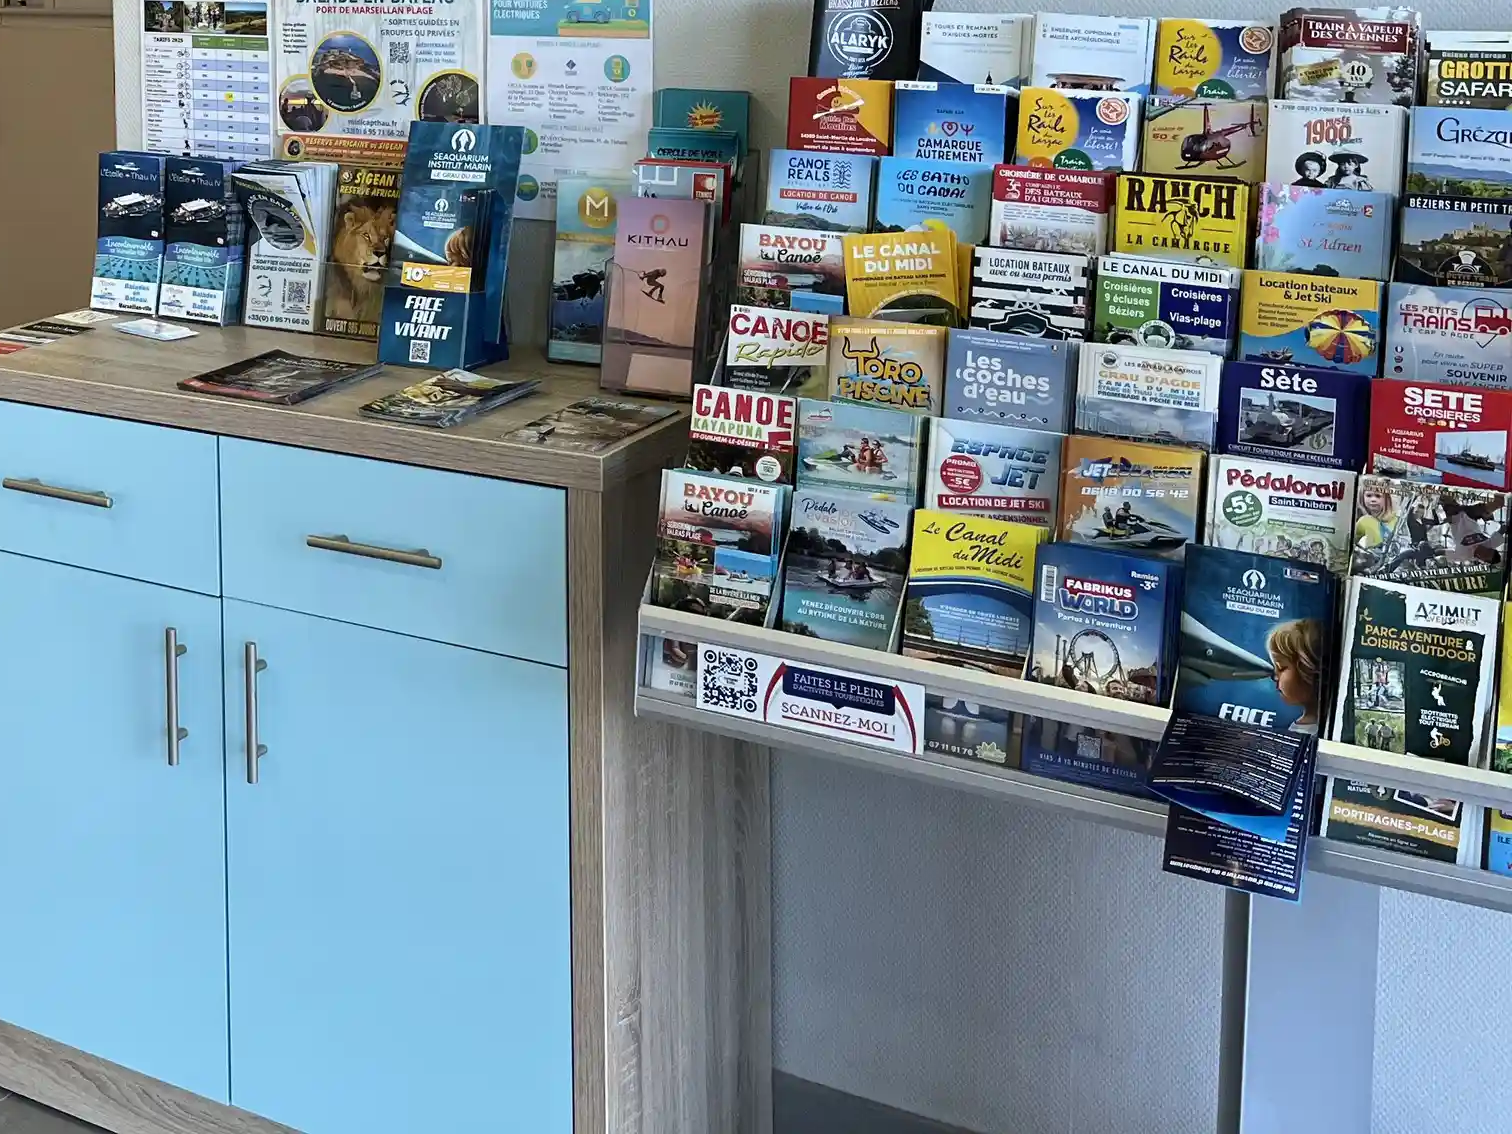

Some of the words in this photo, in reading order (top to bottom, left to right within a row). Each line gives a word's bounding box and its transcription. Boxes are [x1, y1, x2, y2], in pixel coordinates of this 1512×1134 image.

[316, 6, 337, 14] PORT
[352, 7, 404, 15] MARSEILLAN
[406, 7, 433, 15] PLAGE
[493, 0, 512, 8] POUR
[513, 0, 548, 9] VOITURES
[831, 32, 888, 49] ALARYK
[917, 137, 982, 151] CAMARGUE
[433, 152, 489, 163] SEAQUARIUM
[788, 157, 831, 170] CANOE
[915, 148, 984, 164] AUTREMENT
[428, 160, 463, 171] INSTITUT
[464, 162, 492, 171] MARIN
[354, 169, 395, 184] SIGEAN
[788, 169, 830, 181] REALS
[918, 185, 966, 198] CANAL
[1125, 177, 1238, 220] RANCH
[1409, 197, 1450, 210] BÉZIERS
[1454, 201, 1466, 211] EN
[1471, 201, 1498, 213] PETIT
[627, 234, 689, 247] KITHAU
[759, 233, 827, 251] BAYOU
[853, 246, 876, 259] LE
[880, 244, 941, 257] CANAL
[864, 260, 891, 273] DU
[896, 259, 932, 271] MIDI
[989, 257, 1030, 270] LOCATION
[1032, 262, 1070, 273] BATEAUX
[1102, 261, 1119, 272] LE
[1123, 264, 1167, 278] CANAL
[1171, 268, 1190, 280] DU
[1194, 271, 1223, 283] MIDI
[1103, 281, 1153, 295] Croisières
[1259, 277, 1308, 291] Location
[1310, 282, 1358, 295] bateaux
[404, 295, 445, 311] FACE
[1171, 288, 1223, 303] Croisières
[410, 309, 436, 325] AU
[1108, 305, 1145, 318] Béziers
[1422, 306, 1458, 315] PETITS
[731, 313, 828, 345] CANOE
[1169, 312, 1222, 328] Vias-plage
[1400, 312, 1472, 331] TRAINS
[394, 321, 452, 341] VIVANT
[843, 336, 923, 385] TORO
[966, 350, 1002, 371] Les
[1260, 368, 1318, 394] Sète
[1447, 370, 1507, 382] SOUVENIR
[838, 377, 931, 408] PISCINE
[963, 385, 1026, 406] d'eau
[1403, 386, 1483, 413] SETE
[696, 388, 795, 429] CANOE
[1404, 406, 1481, 423] CROISIERES
[692, 418, 763, 439] KAYAPUNA
[950, 438, 1050, 465] ESPACE
[1228, 444, 1251, 454] CIRCUIT
[1252, 446, 1292, 459] TOURISTIQUE
[1293, 452, 1305, 460] PAR
[1306, 454, 1343, 466] EXCELLENCE
[991, 464, 1046, 491] JET
[1226, 468, 1346, 501] Pédalorail
[683, 482, 754, 507] BAYOU
[942, 496, 986, 508] LOCATION
[987, 498, 1002, 508] DE
[1003, 498, 1026, 509] JET
[1028, 500, 1045, 509] SKI
[802, 497, 838, 514] Pédalo
[1271, 497, 1335, 512] Saint-Thibéry
[922, 522, 940, 536] Le
[945, 522, 1008, 547] Canal
[952, 549, 969, 561] du
[969, 544, 1024, 570] Midi
[1065, 579, 1132, 599] FABRIKUS
[801, 599, 823, 610] VENEZ
[824, 602, 864, 617] DÉCOUVRIR
[865, 610, 885, 621] L'ORB
[1058, 588, 1138, 620] WORLD
[1415, 601, 1482, 622] AZIMUT
[1364, 624, 1399, 638] PARC
[1400, 629, 1464, 648] AVENTURE
[1360, 634, 1408, 652] LOISIRS
[1410, 642, 1477, 663] OUTDOOR
[794, 673, 832, 690] FAITES
[834, 680, 848, 692] LE
[850, 682, 884, 699] PLEIN
[1419, 668, 1468, 686] ACCROBRANCHE
[780, 702, 888, 735] SCANNEZ-MOI
[1218, 702, 1277, 728] FACE
[1333, 805, 1455, 841] PORTIRAGNES-PLAGE
